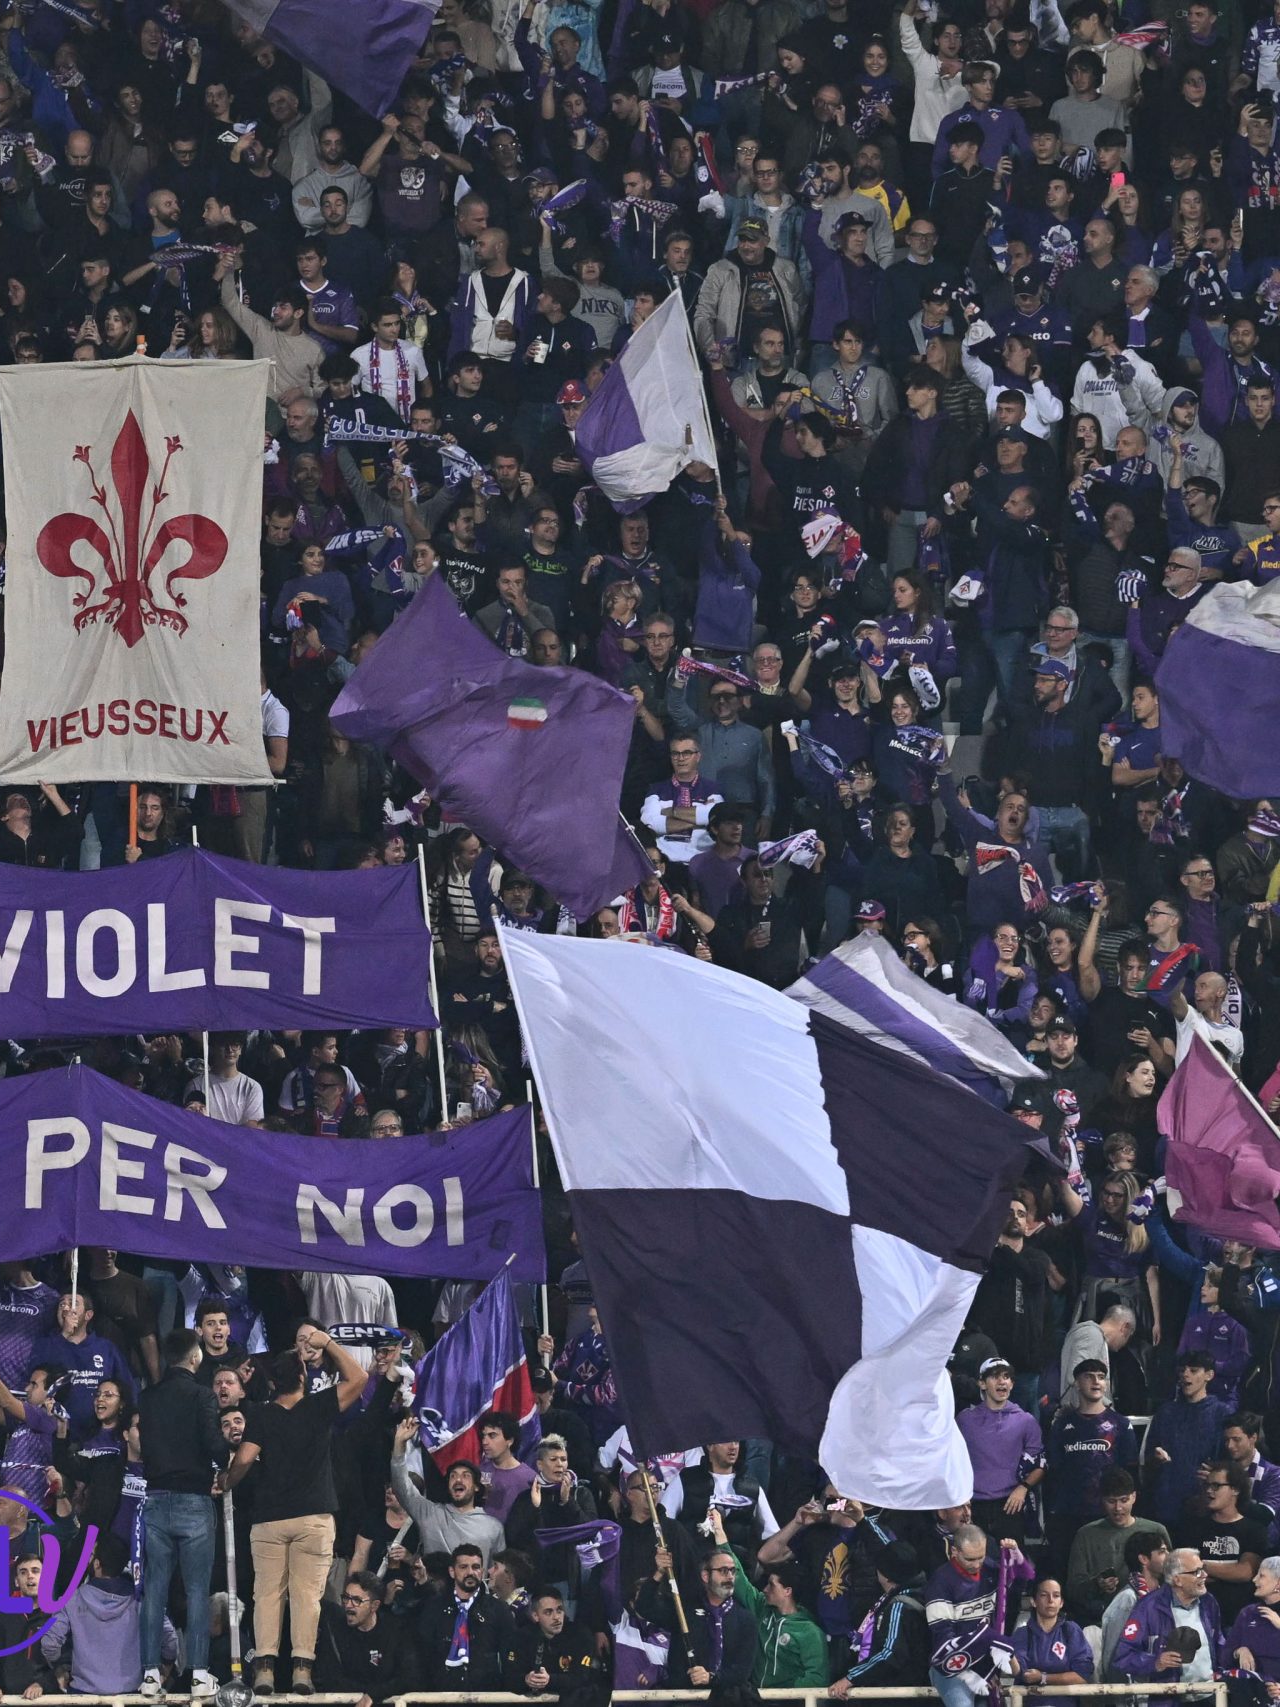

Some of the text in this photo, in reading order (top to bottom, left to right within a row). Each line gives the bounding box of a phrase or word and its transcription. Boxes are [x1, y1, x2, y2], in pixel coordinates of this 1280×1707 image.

[580, 297, 620, 316] NIKE
[887, 635, 929, 647] Mediacom
[28, 697, 230, 753] VIEUSSEUX
[25, 1117, 228, 1229] PER
[296, 1177, 464, 1248] NOI
